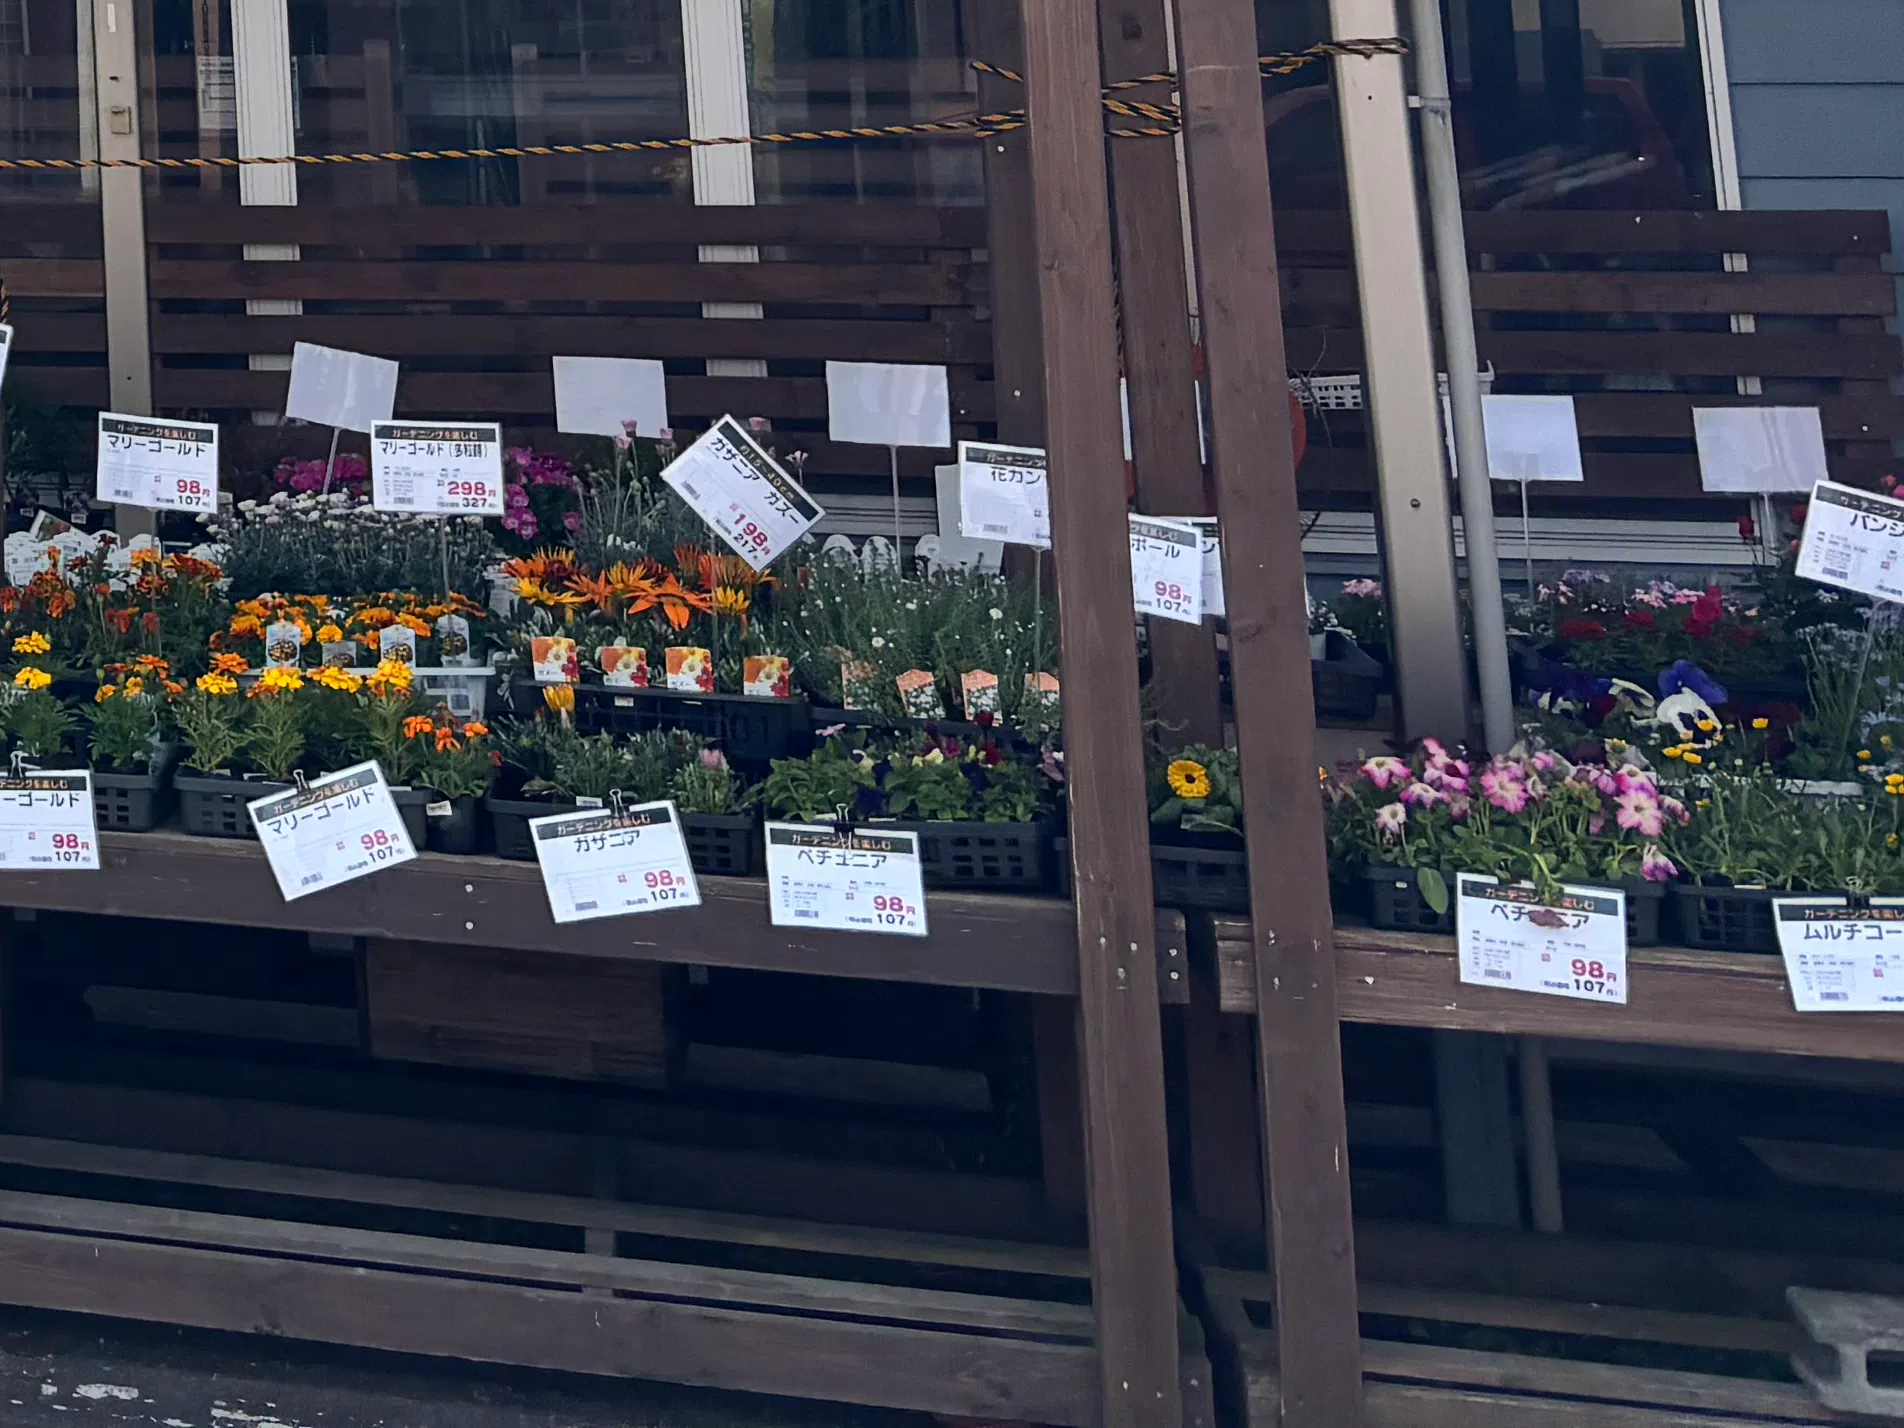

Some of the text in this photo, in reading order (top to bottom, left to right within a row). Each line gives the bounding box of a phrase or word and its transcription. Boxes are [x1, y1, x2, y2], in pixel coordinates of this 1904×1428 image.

[108, 435, 206, 457] マリーゴールド
[380, 442, 444, 456] マリーゴールド
[710, 437, 760, 482] ガザニア
[178, 496, 201, 506] 107
[463, 498, 487, 508] 327
[1156, 598, 1181, 612] 107
[267, 787, 375, 835] マリーゴールド
[574, 830, 641, 853] ガザニア
[56, 851, 80, 862] 107
[368, 846, 394, 863] 107
[651, 888, 677, 902] 107
[1804, 923, 1902, 940] ムルチコー
